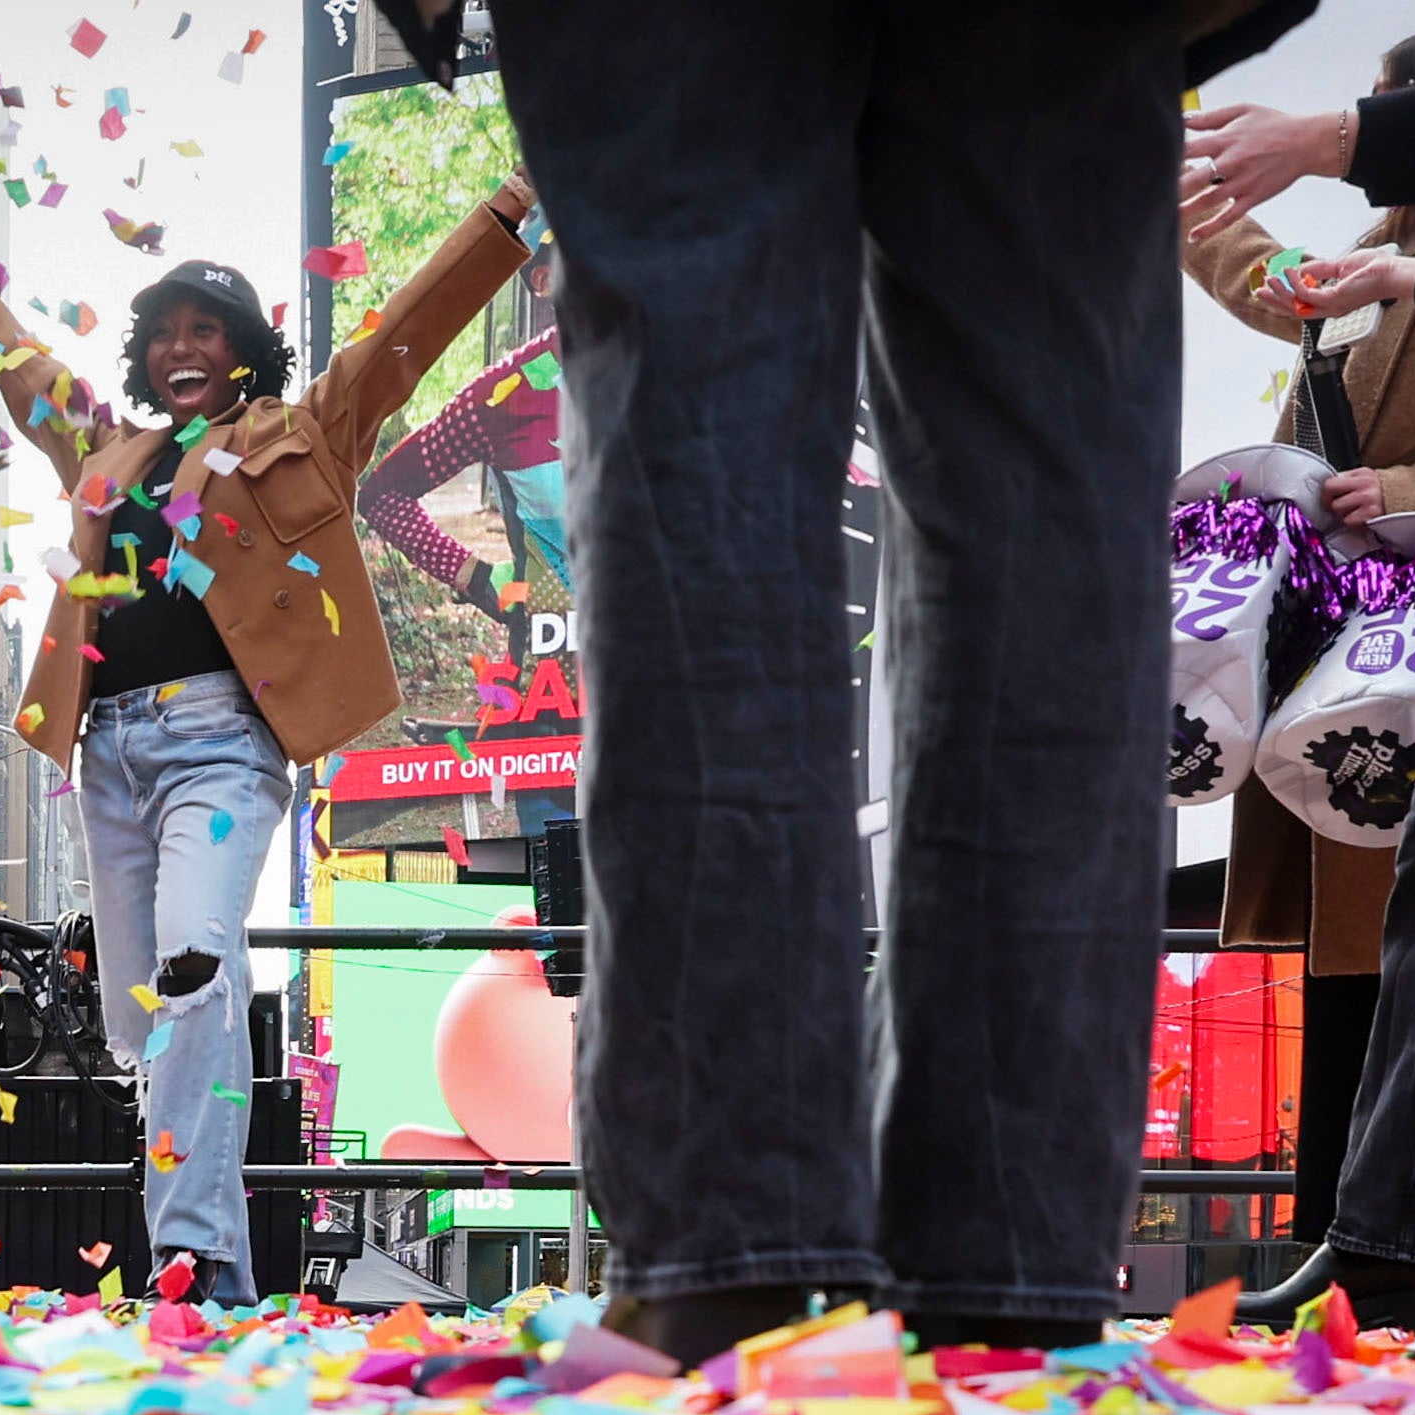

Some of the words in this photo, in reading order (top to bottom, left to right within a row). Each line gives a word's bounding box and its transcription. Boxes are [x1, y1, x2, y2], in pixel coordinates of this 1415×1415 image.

[1361, 633, 1396, 648] EVE
[1354, 653, 1392, 666] NEW
[382, 761, 428, 784] BUY
[433, 759, 455, 780] IT
[460, 759, 494, 779] ON
